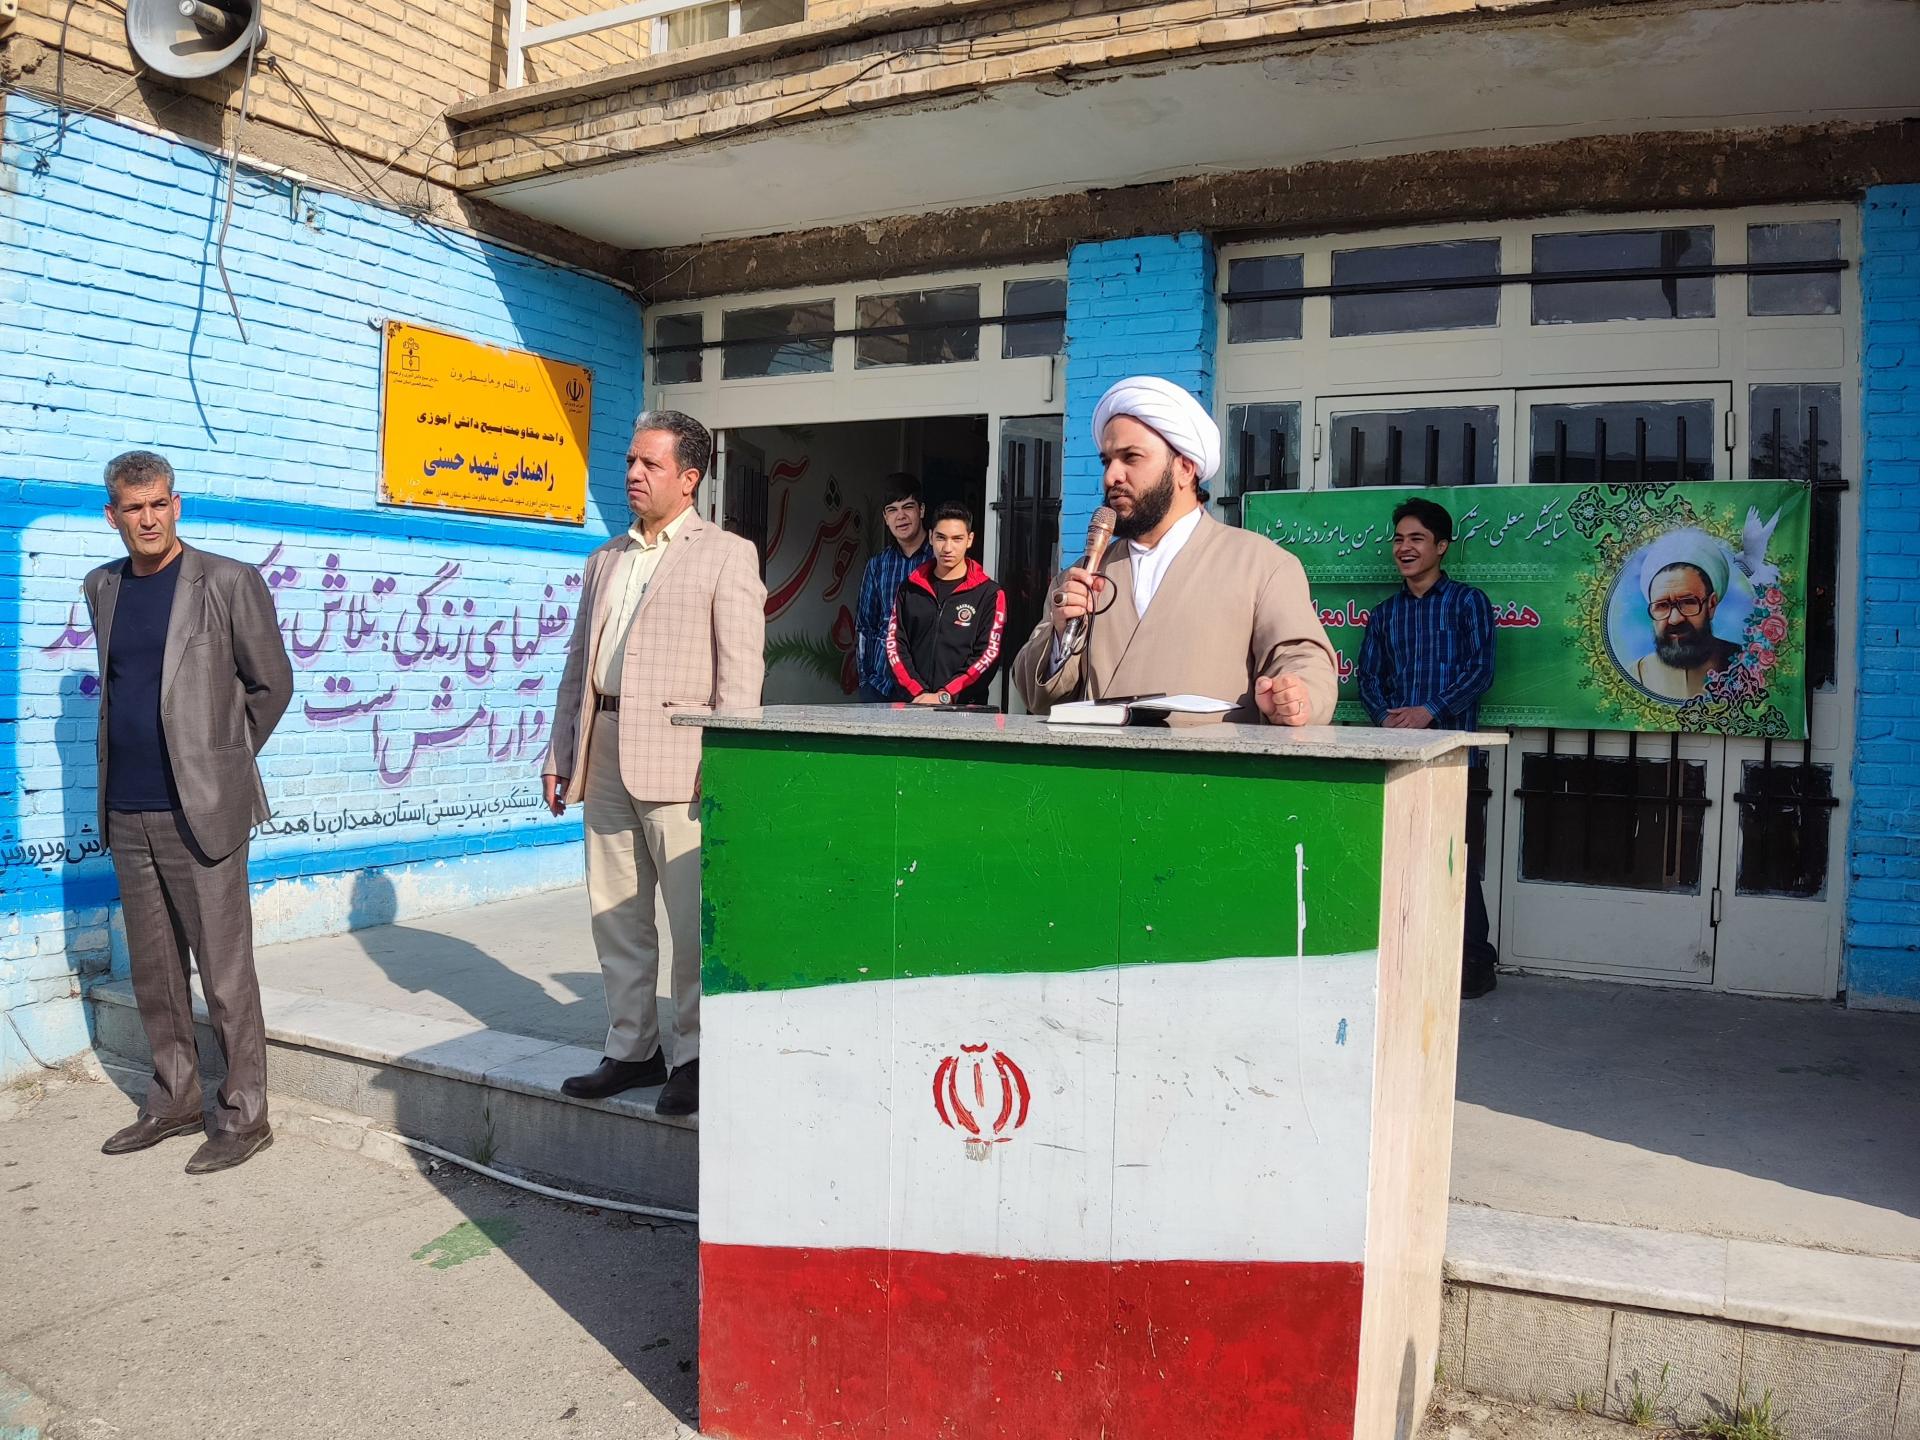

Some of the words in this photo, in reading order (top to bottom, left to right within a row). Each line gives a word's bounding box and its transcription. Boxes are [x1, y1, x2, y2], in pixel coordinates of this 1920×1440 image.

[417, 411, 451, 426] آموزی
[455, 416, 479, 429] دانش
[480, 422, 502, 436] بسیج
[503, 426, 539, 439] مقاومت
[542, 433, 564, 446] واحد
[423, 447, 465, 476] حسنی
[469, 452, 499, 481] شهید
[502, 456, 554, 491] راهنمایی
[1351, 523, 1375, 549] من
[1525, 497, 1568, 546] ستایشگر
[292, 552, 397, 659] تلاش
[1494, 601, 1541, 628] هفت
[886, 606, 900, 667] ASHOKE
[974, 611, 1005, 675] PASHOKE
[383, 799, 426, 827] استان
[426, 793, 487, 827] بهزیستی
[488, 786, 538, 825] پیشگیری
[313, 811, 326, 842] با
[328, 808, 382, 834] همدان
